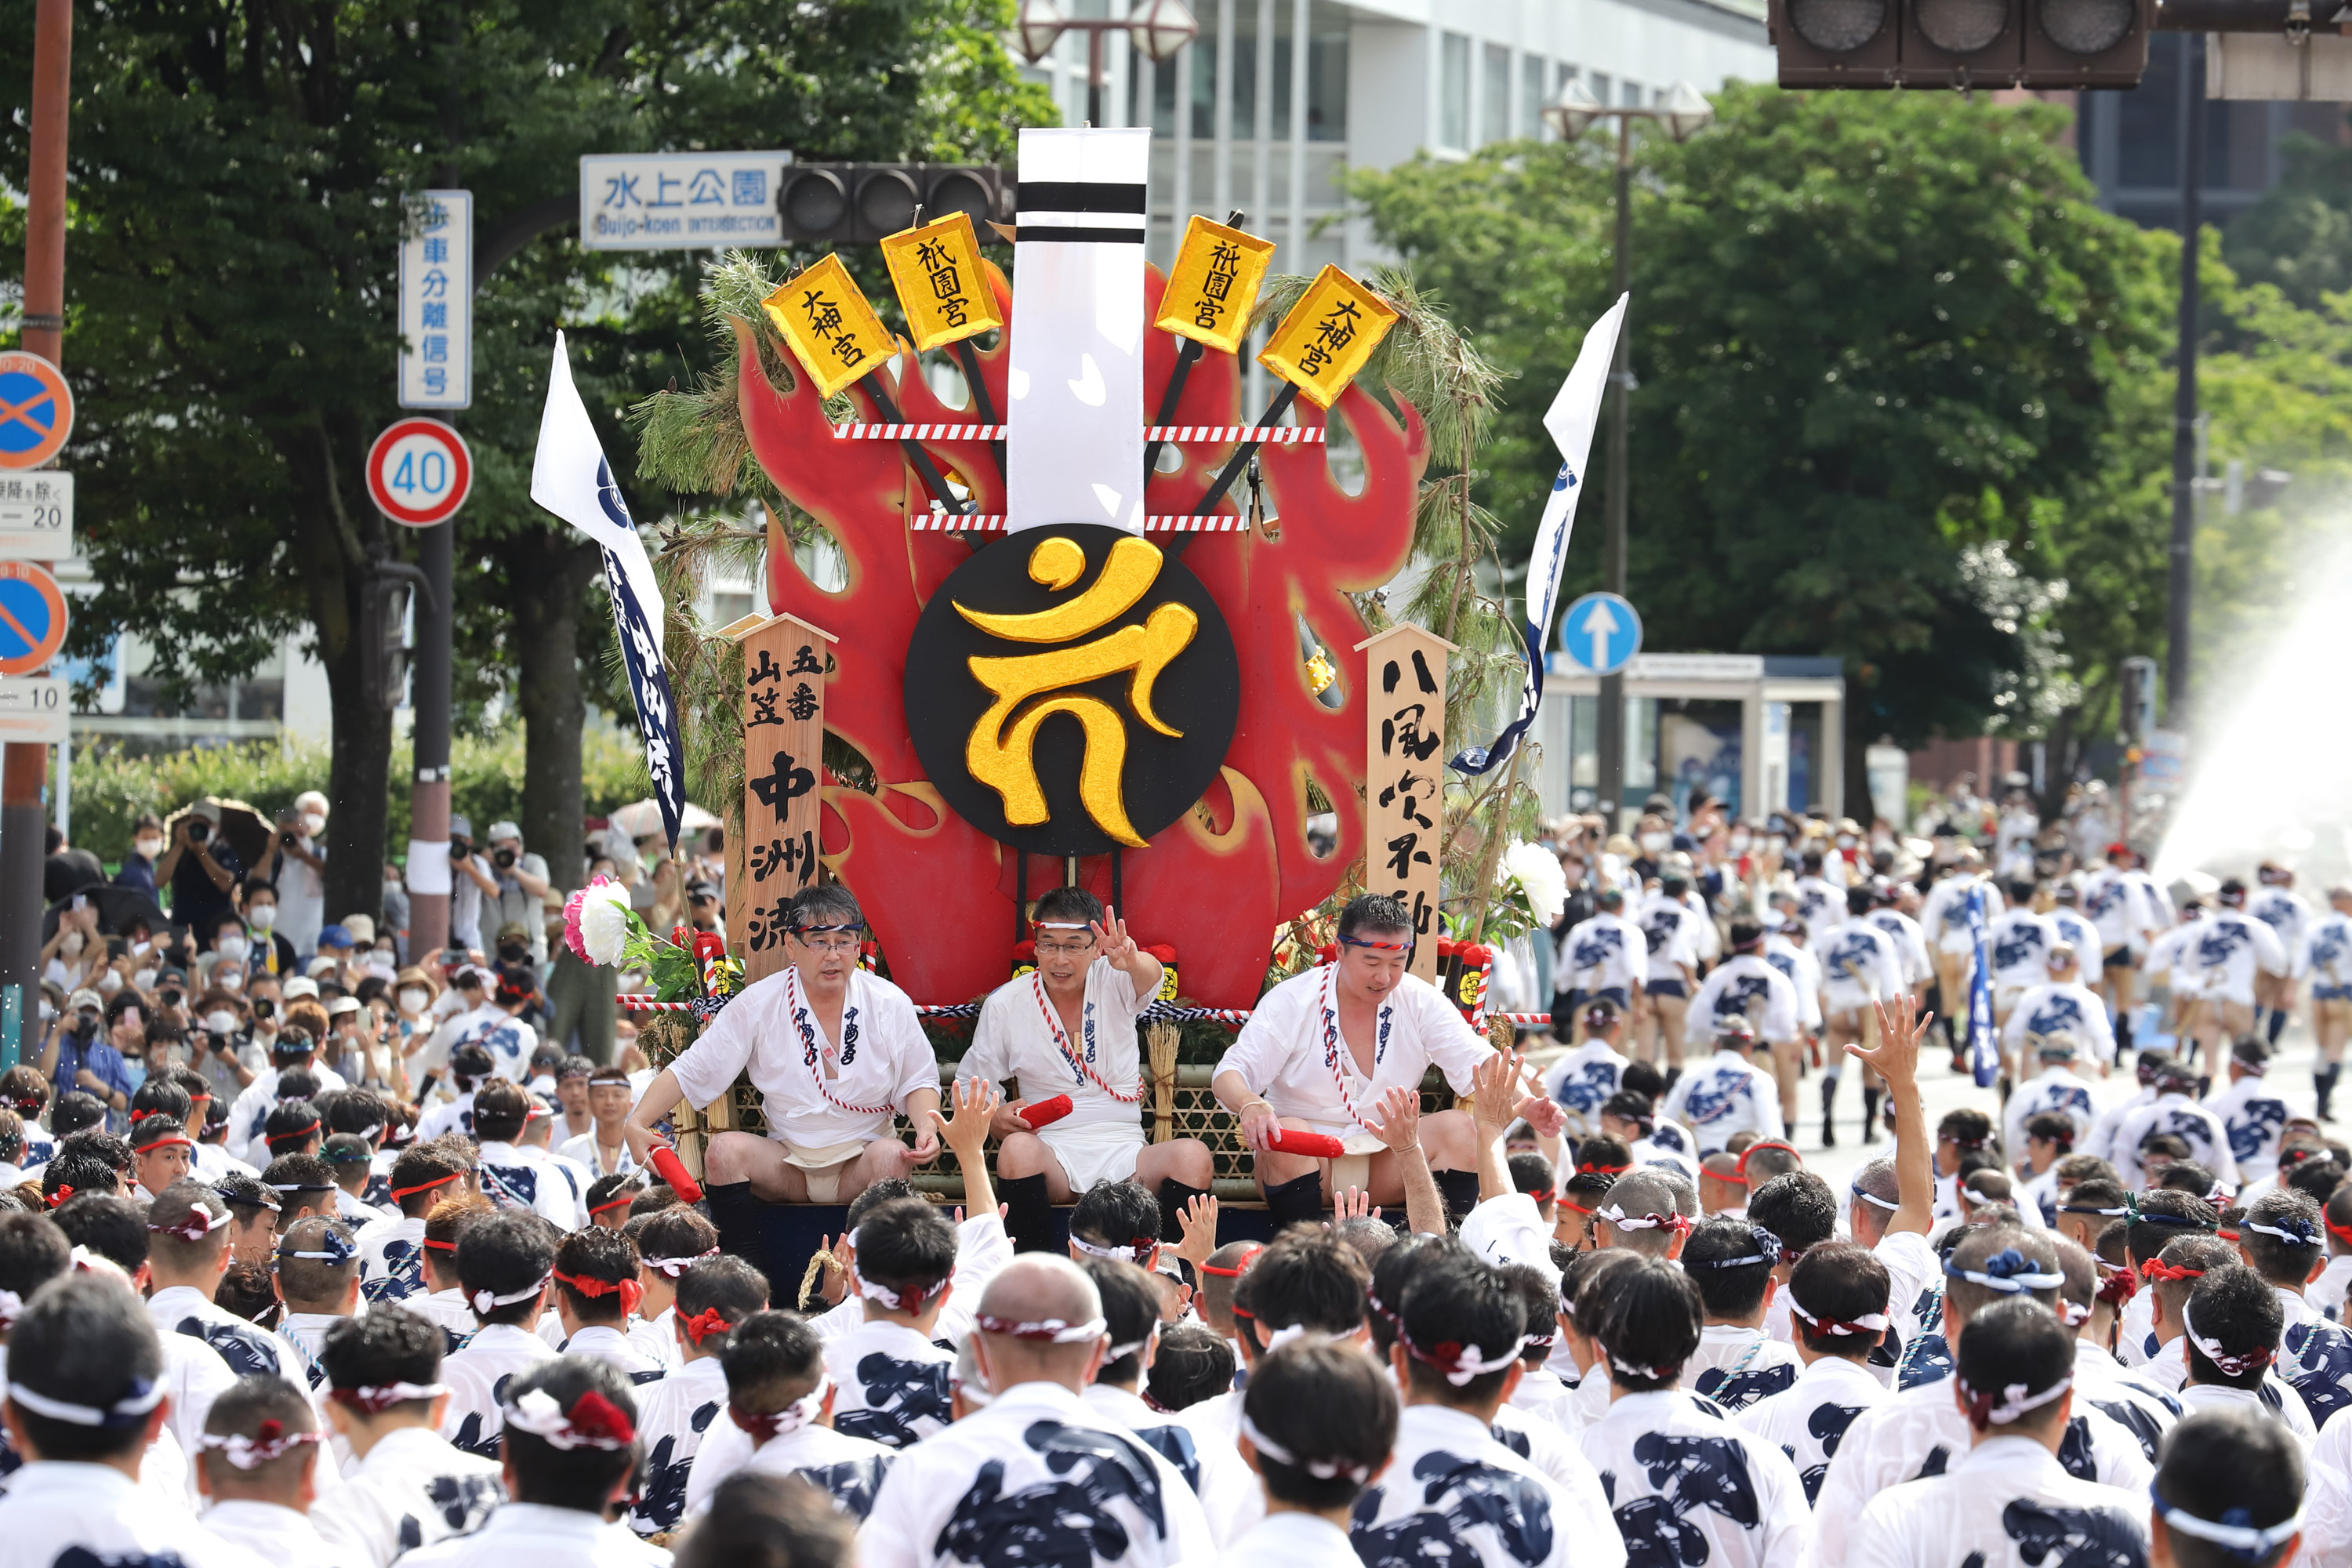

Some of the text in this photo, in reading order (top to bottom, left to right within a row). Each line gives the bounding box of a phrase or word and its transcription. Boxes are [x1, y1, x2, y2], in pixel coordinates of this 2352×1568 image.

[604, 169, 766, 209] 水上公園
[916, 237, 968, 328] 祇園宮
[1194, 240, 1240, 330] 祇園宮
[802, 290, 866, 368] 大神宮
[1298, 300, 1362, 377] 大神宮
[394, 451, 447, 495] 40
[746, 651, 784, 728] 山笠
[786, 645, 823, 720] 五番
